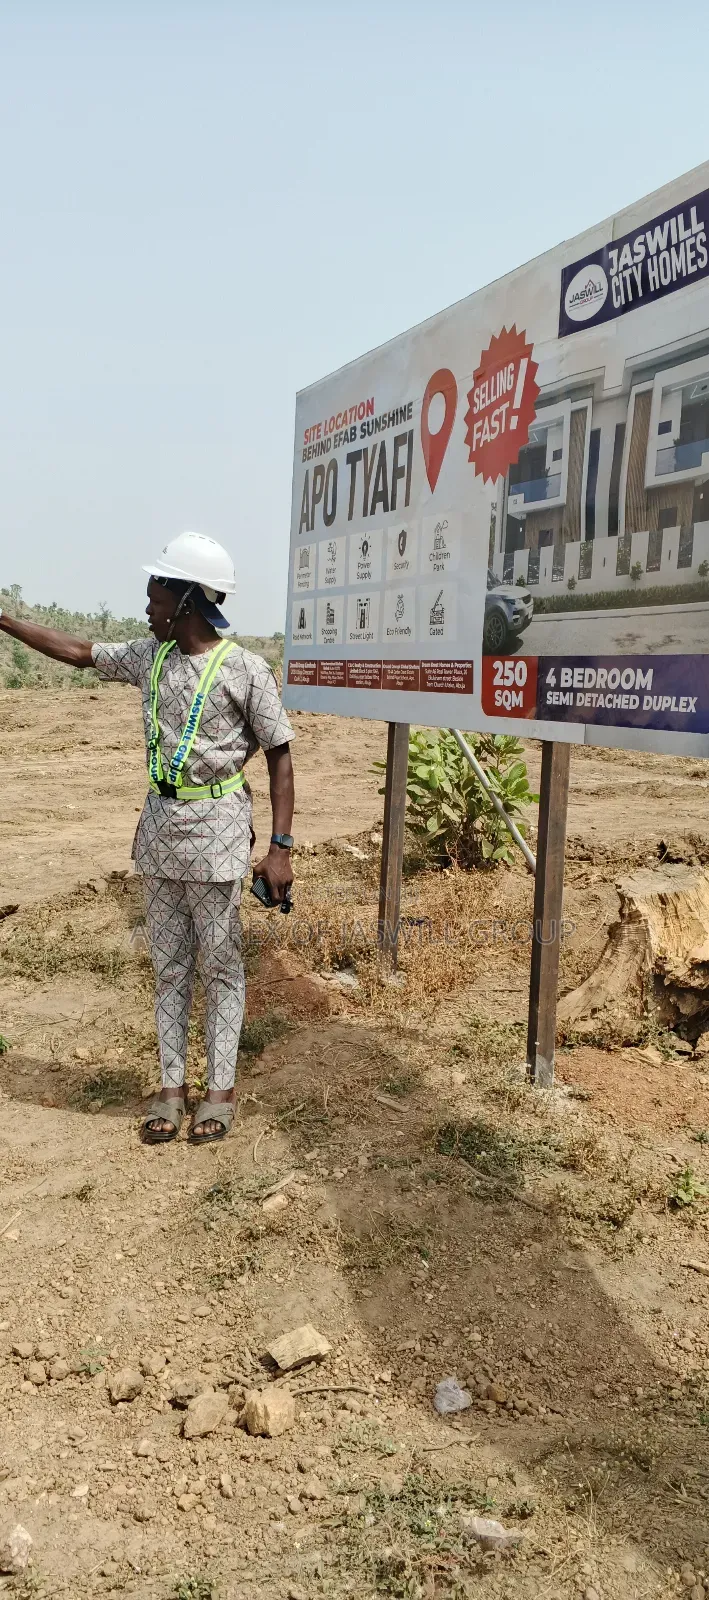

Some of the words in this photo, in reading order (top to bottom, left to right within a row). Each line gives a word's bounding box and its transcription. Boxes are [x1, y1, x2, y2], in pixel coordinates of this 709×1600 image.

[608, 206, 704, 276] JASWILL
[612, 262, 643, 308] CITY
[647, 231, 708, 291] HOMES
[569, 282, 603, 303] JASWILL
[473, 363, 514, 414] SELLING
[302, 438, 331, 463] BEHIND
[333, 426, 357, 449] EFAB
[360, 401, 413, 439] SUNSHINE
[304, 422, 321, 445] SITE
[324, 397, 374, 436] LOCATION
[299, 458, 338, 534] APO
[346, 429, 414, 521] TYAFI
[358, 561, 371, 570] Power
[394, 560, 409, 570] Security
[429, 551, 450, 561] Children
[433, 563, 445, 571] Park
[357, 571, 372, 580] Supply
[349, 632, 362, 640] Street
[363, 632, 374, 641] Light
[395, 626, 411, 636] Friendly
[430, 628, 444, 636] Gated
[493, 660, 527, 687] 250
[546, 668, 557, 688] 4
[561, 668, 653, 690] BEDROOM
[494, 690, 523, 710] SQM
[546, 691, 573, 706] SEMI
[576, 693, 639, 710] DETACHED
[642, 695, 698, 713] DUPLEX
[183, 692, 204, 741] JASWILL
[169, 745, 187, 782] GROUP
